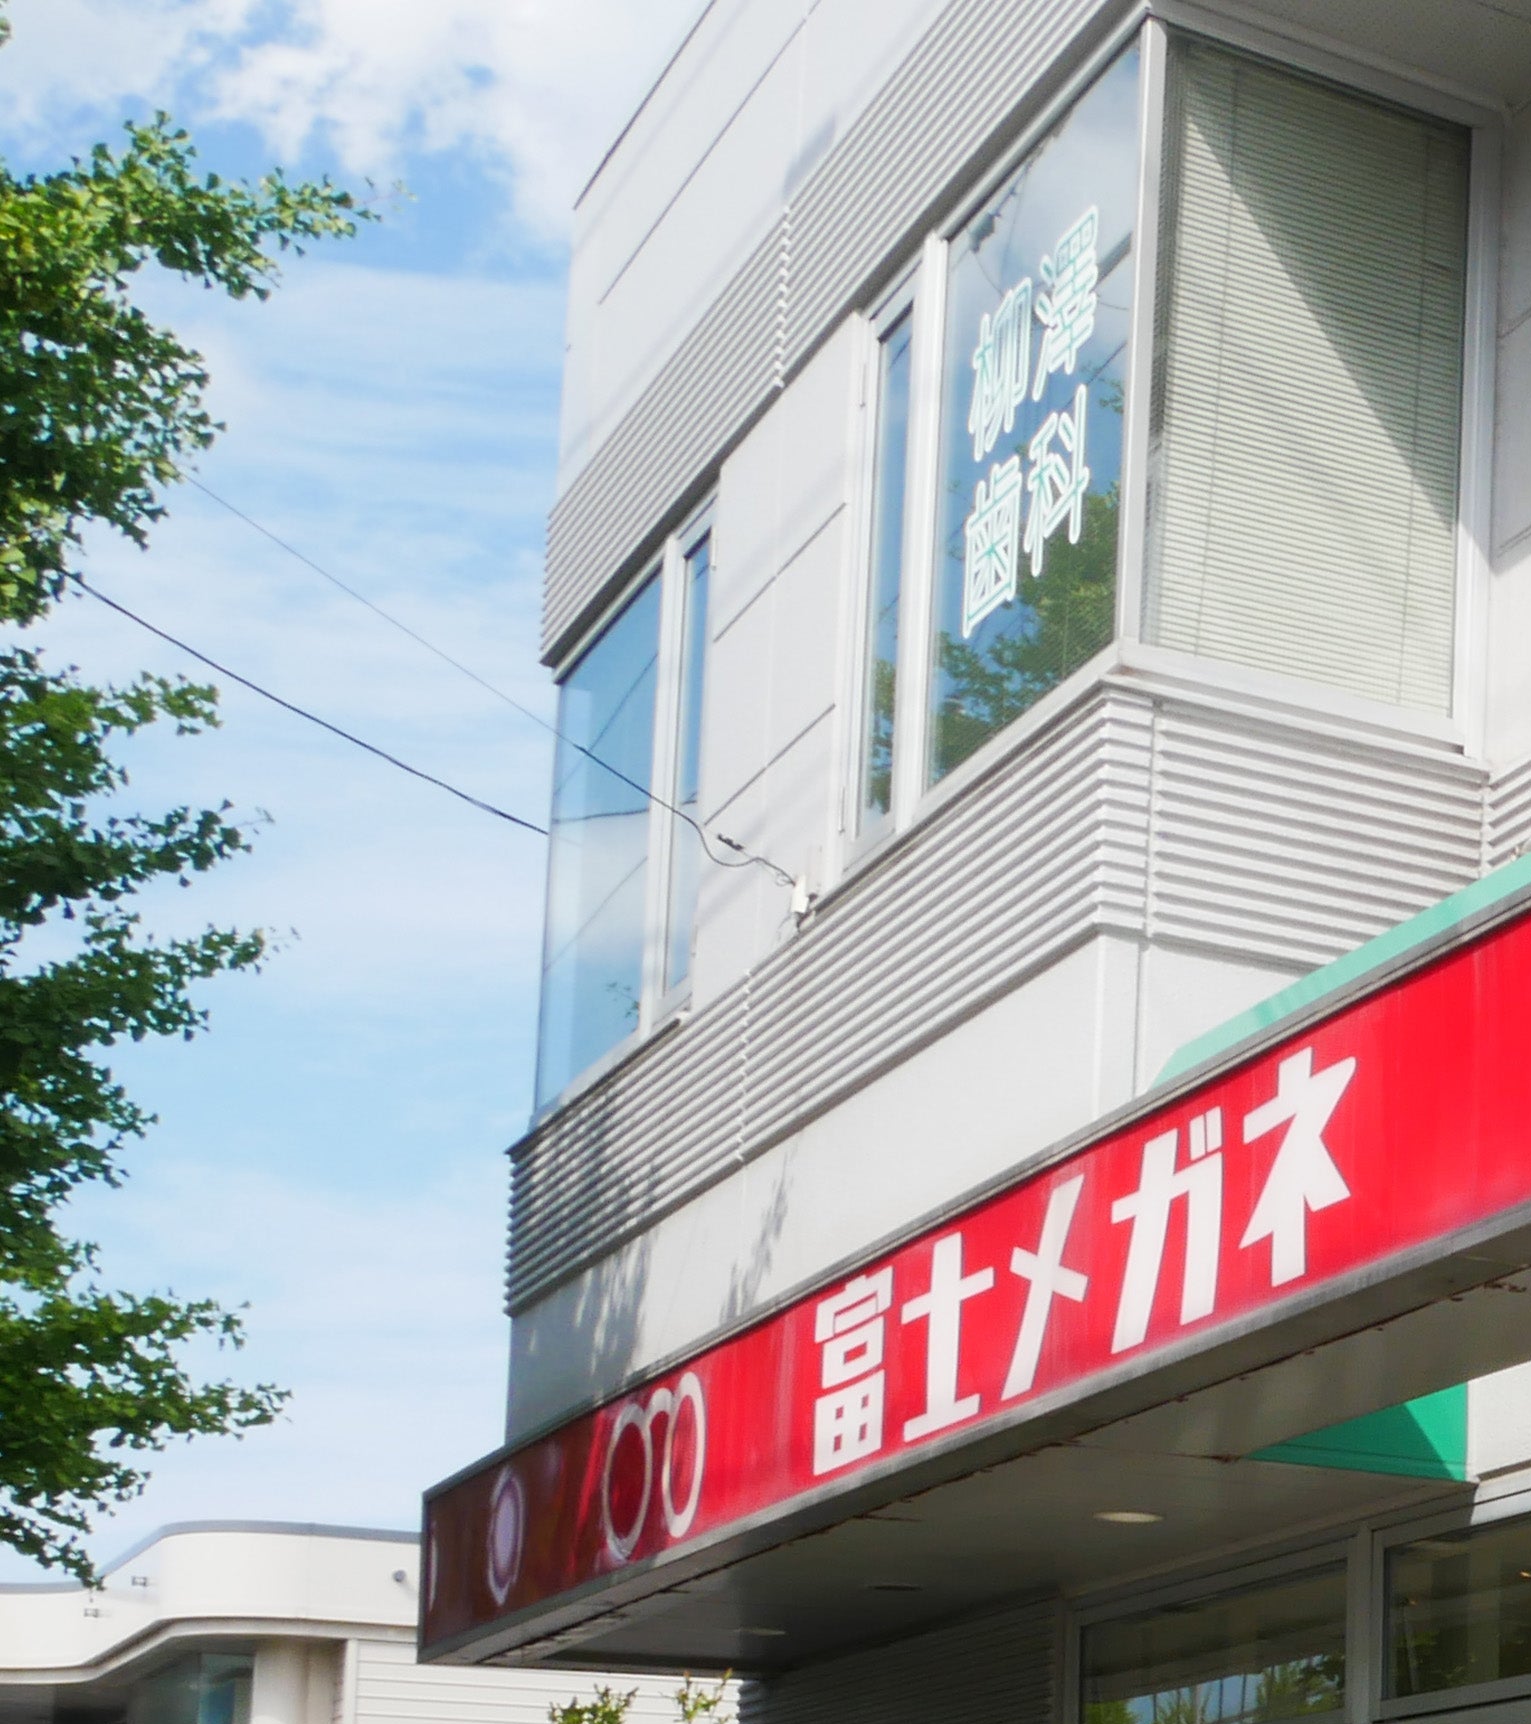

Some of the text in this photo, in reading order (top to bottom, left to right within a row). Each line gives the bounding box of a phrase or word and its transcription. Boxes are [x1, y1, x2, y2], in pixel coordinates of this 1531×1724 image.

[969, 206, 1098, 463] 柳澤
[963, 384, 1090, 640] 歯科
[813, 1046, 1357, 1476] 富士メガネ
